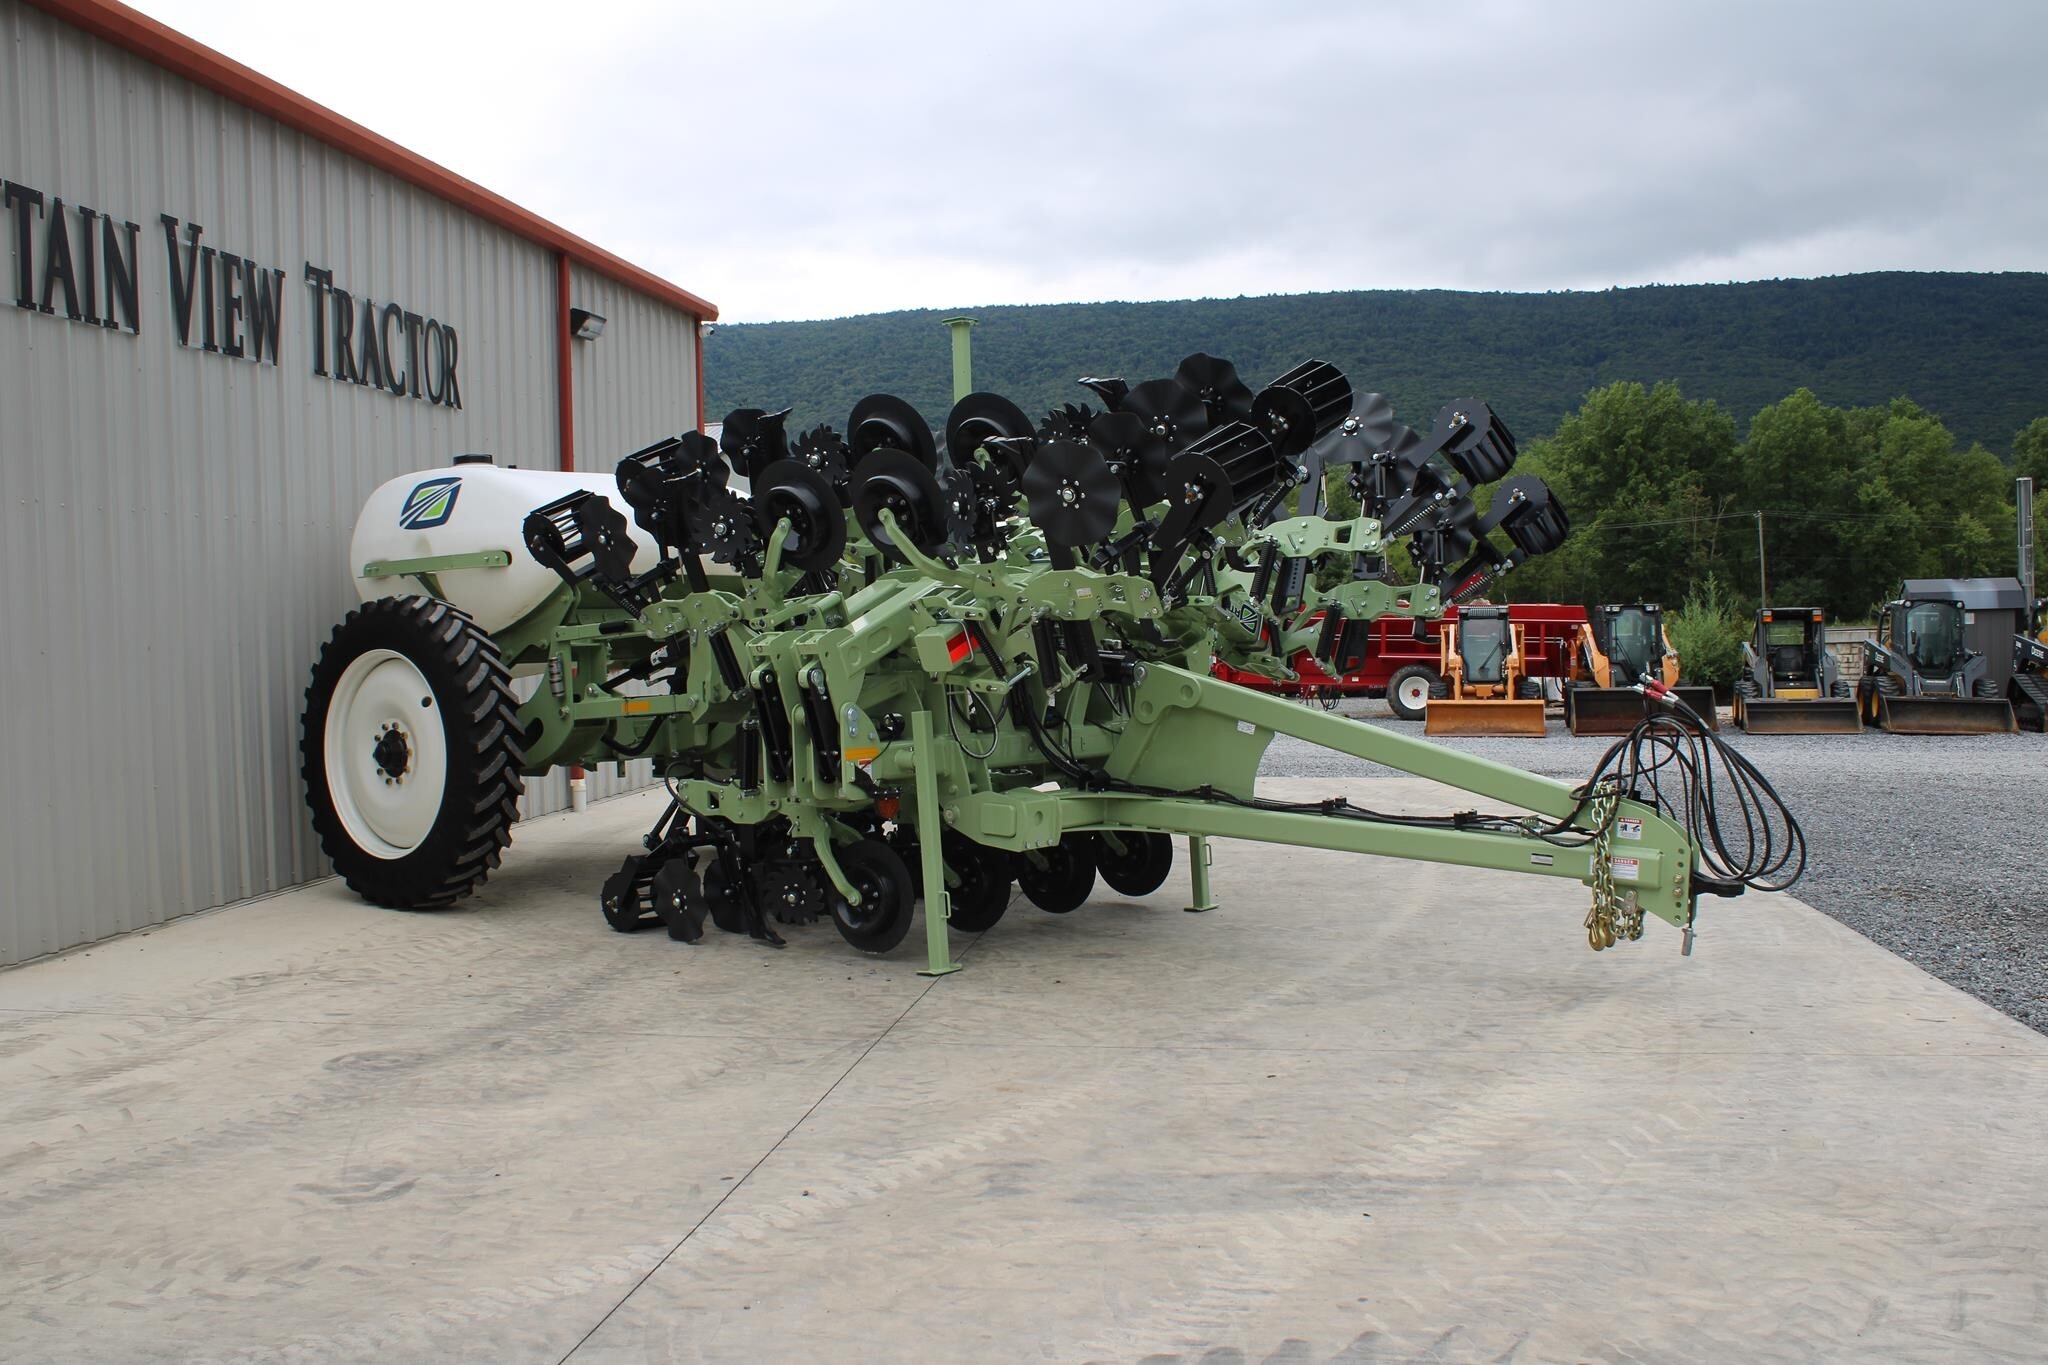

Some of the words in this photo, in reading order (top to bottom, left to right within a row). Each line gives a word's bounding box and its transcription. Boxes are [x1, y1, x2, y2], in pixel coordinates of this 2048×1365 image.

[0, 178, 141, 335] TAIN
[160, 213, 287, 366] VIEW
[305, 261, 463, 410] TRACTOR
